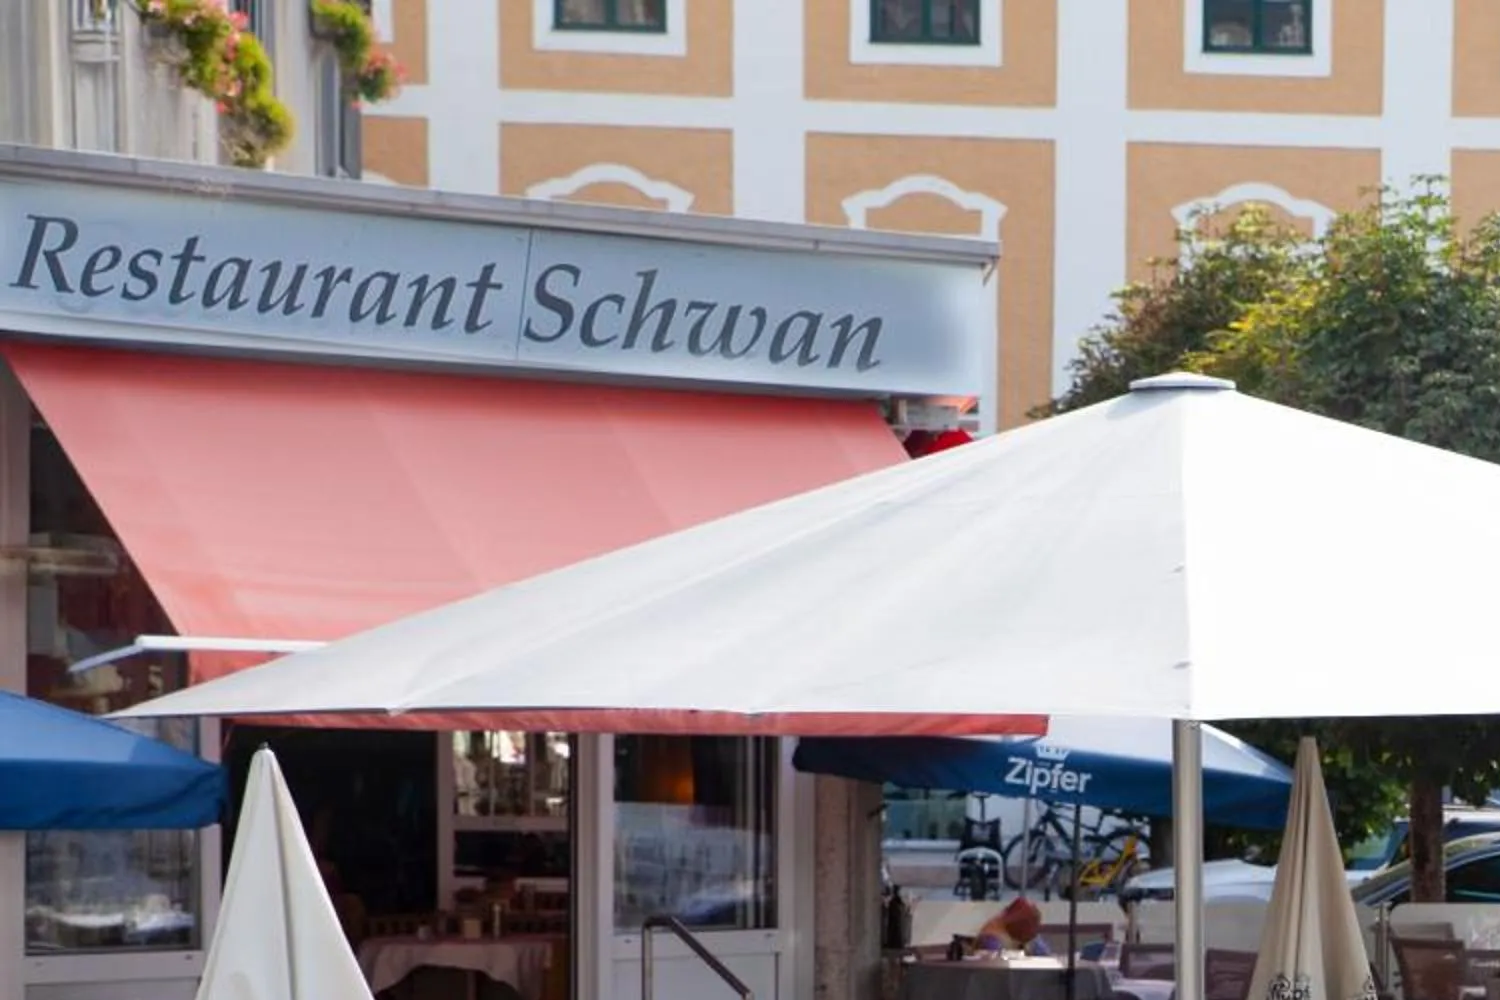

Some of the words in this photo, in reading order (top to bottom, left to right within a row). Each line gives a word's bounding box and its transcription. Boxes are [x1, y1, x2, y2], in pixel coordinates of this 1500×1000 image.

[9, 214, 503, 335] Restaurant
[522, 262, 885, 372] Schwan
[1004, 756, 1093, 794] Zipfer
